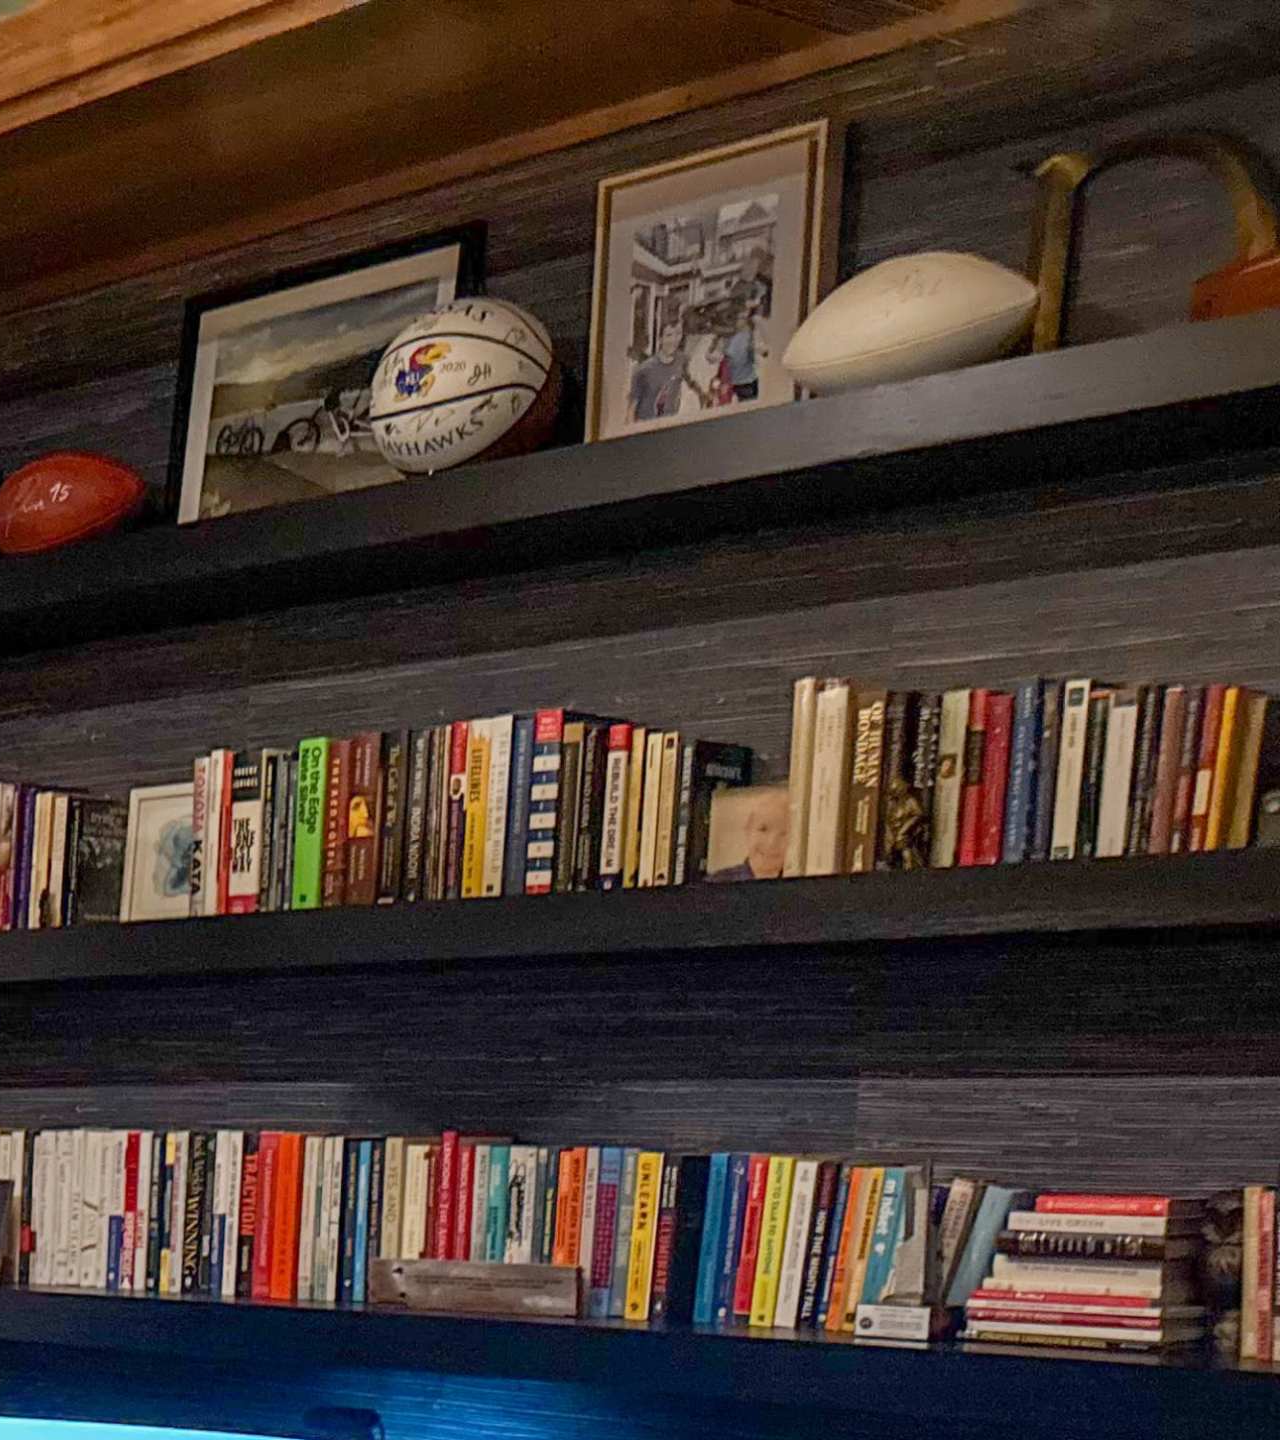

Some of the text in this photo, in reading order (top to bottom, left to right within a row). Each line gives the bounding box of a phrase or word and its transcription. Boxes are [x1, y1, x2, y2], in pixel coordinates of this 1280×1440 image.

[298, 748, 310, 825] Nate Silver
[307, 747, 322, 834] On the Edge
[470, 748, 484, 803] LIFELINES
[609, 758, 622, 803] REBUILD
[191, 765, 206, 896] TOYOTA KATA
[608, 807, 618, 826] THE
[240, 1153, 258, 1236] TRACTION
[637, 1162, 651, 1230] UNLEARN
[773, 1187, 782, 1199] TO
[876, 1180, 898, 1235] mindset
[184, 1196, 199, 1274] WINNING
[654, 1215, 672, 1294] ILLUMINATE
[802, 1210, 826, 1318] HOW THE MIGHTY FALL
